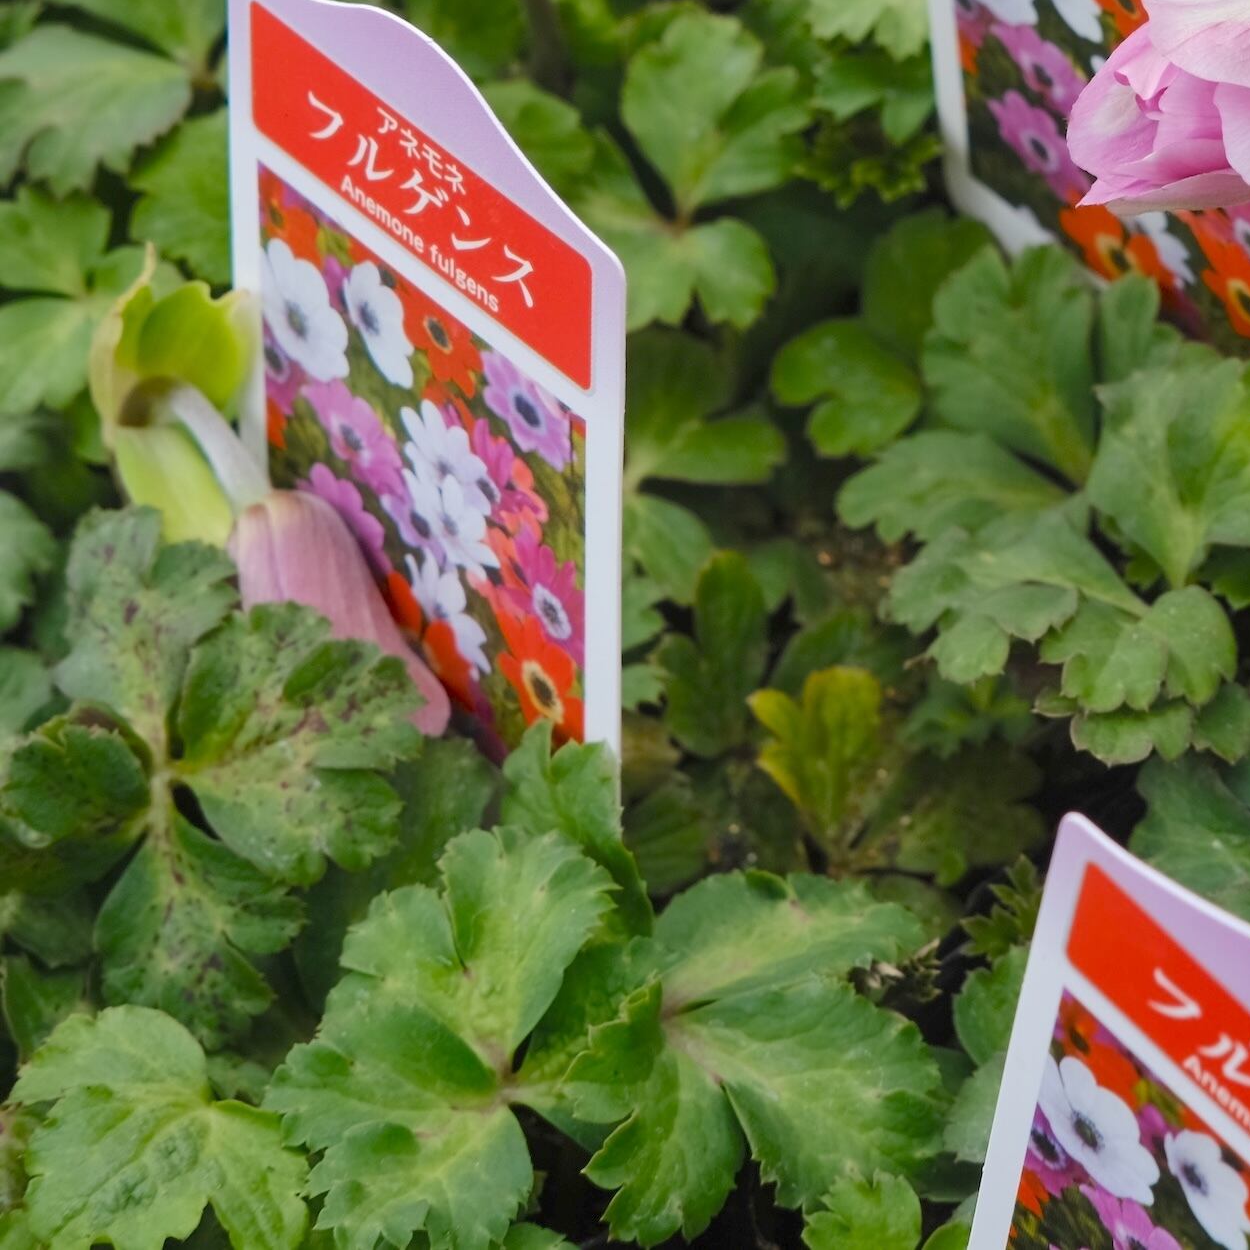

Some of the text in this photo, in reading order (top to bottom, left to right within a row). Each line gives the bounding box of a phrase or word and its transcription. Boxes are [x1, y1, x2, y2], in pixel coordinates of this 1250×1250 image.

[308, 91, 534, 308] フルゲンス
[376, 107, 466, 196] アネモネ
[341, 174, 499, 313] Anemone fulgens
